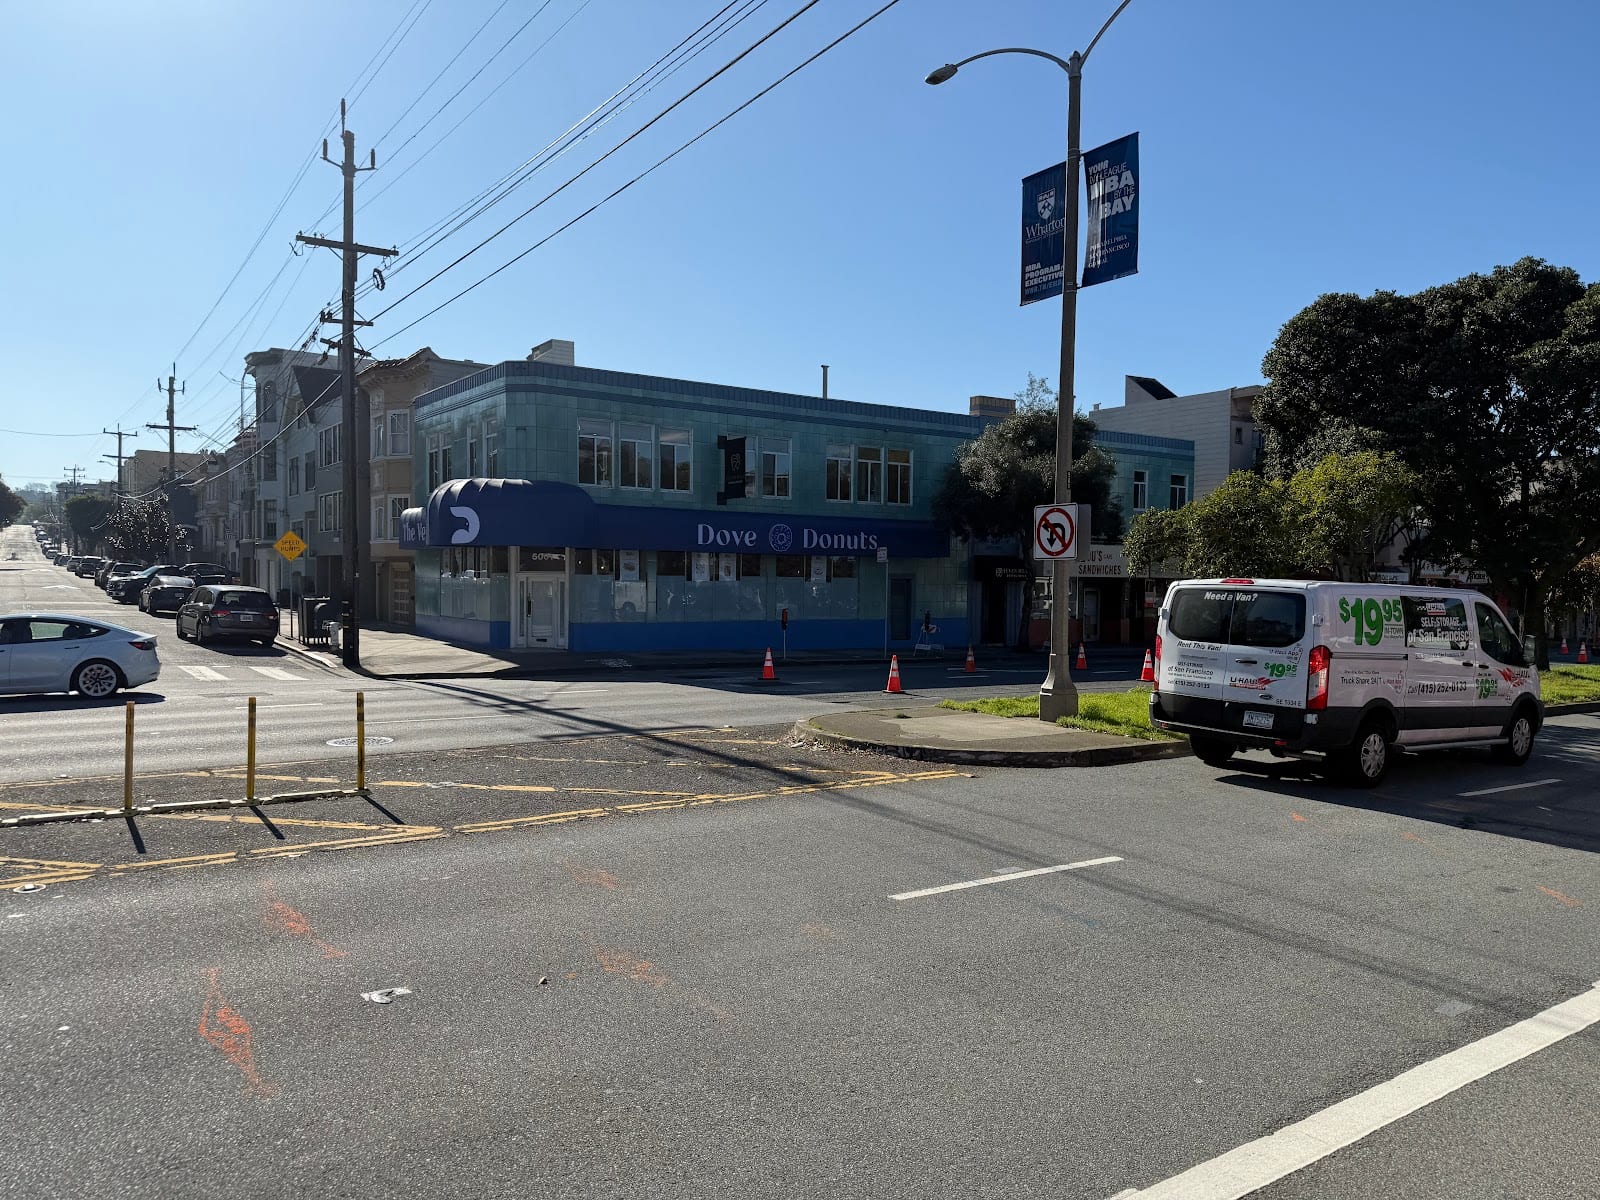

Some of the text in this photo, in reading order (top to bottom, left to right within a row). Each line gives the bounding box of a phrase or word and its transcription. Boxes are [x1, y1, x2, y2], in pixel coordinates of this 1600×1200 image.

[1088, 160, 1109, 174] YOUR
[1090, 170, 1135, 201] MBA
[1113, 184, 1135, 200] BY THE
[1101, 194, 1135, 220] BAY
[1025, 262, 1042, 273] MBA
[1025, 263, 1061, 281] PROGRAM
[403, 522, 416, 542] The
[697, 523, 878, 550] Dove Donuts
[1078, 564, 1121, 575] SANDWICHES
[1204, 591, 1228, 601] Need
[1236, 592, 1258, 602] Van?
[1420, 616, 1460, 628] SELF-STORAGE
[1407, 625, 1473, 643] of San Francisco
[1192, 642, 1206, 650] This
[1341, 676, 1354, 685] Truck
[1355, 676, 1370, 685] Share
[1417, 682, 1436, 695] (415)
[1436, 681, 1467, 693] 252-0133
